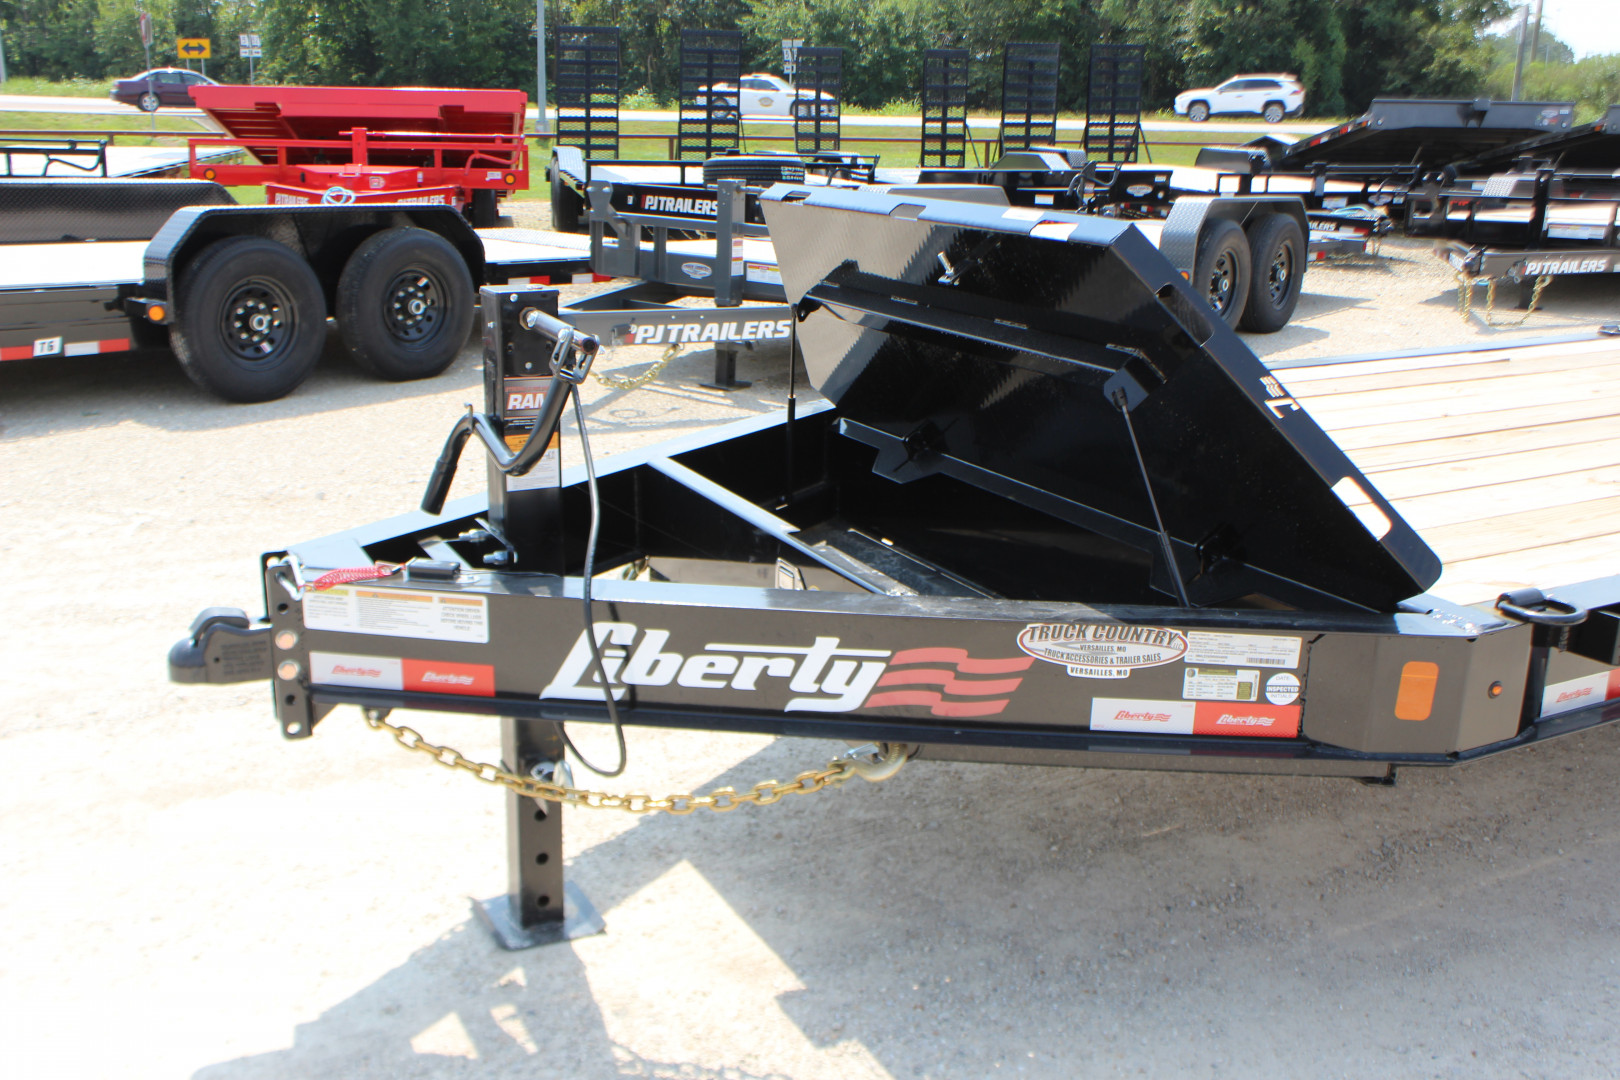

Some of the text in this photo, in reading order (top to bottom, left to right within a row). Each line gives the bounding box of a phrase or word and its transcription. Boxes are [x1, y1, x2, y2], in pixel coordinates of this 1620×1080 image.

[1028, 624, 1180, 646] TRUCK COUNTRY
[1116, 645, 1127, 653] MO
[1044, 647, 1162, 665] TRUCK ACCESSORIES & TRAILER SALES
[539, 621, 890, 713] Liberty
[1116, 668, 1128, 677] MO
[1266, 685, 1299, 693] INSPECTED
